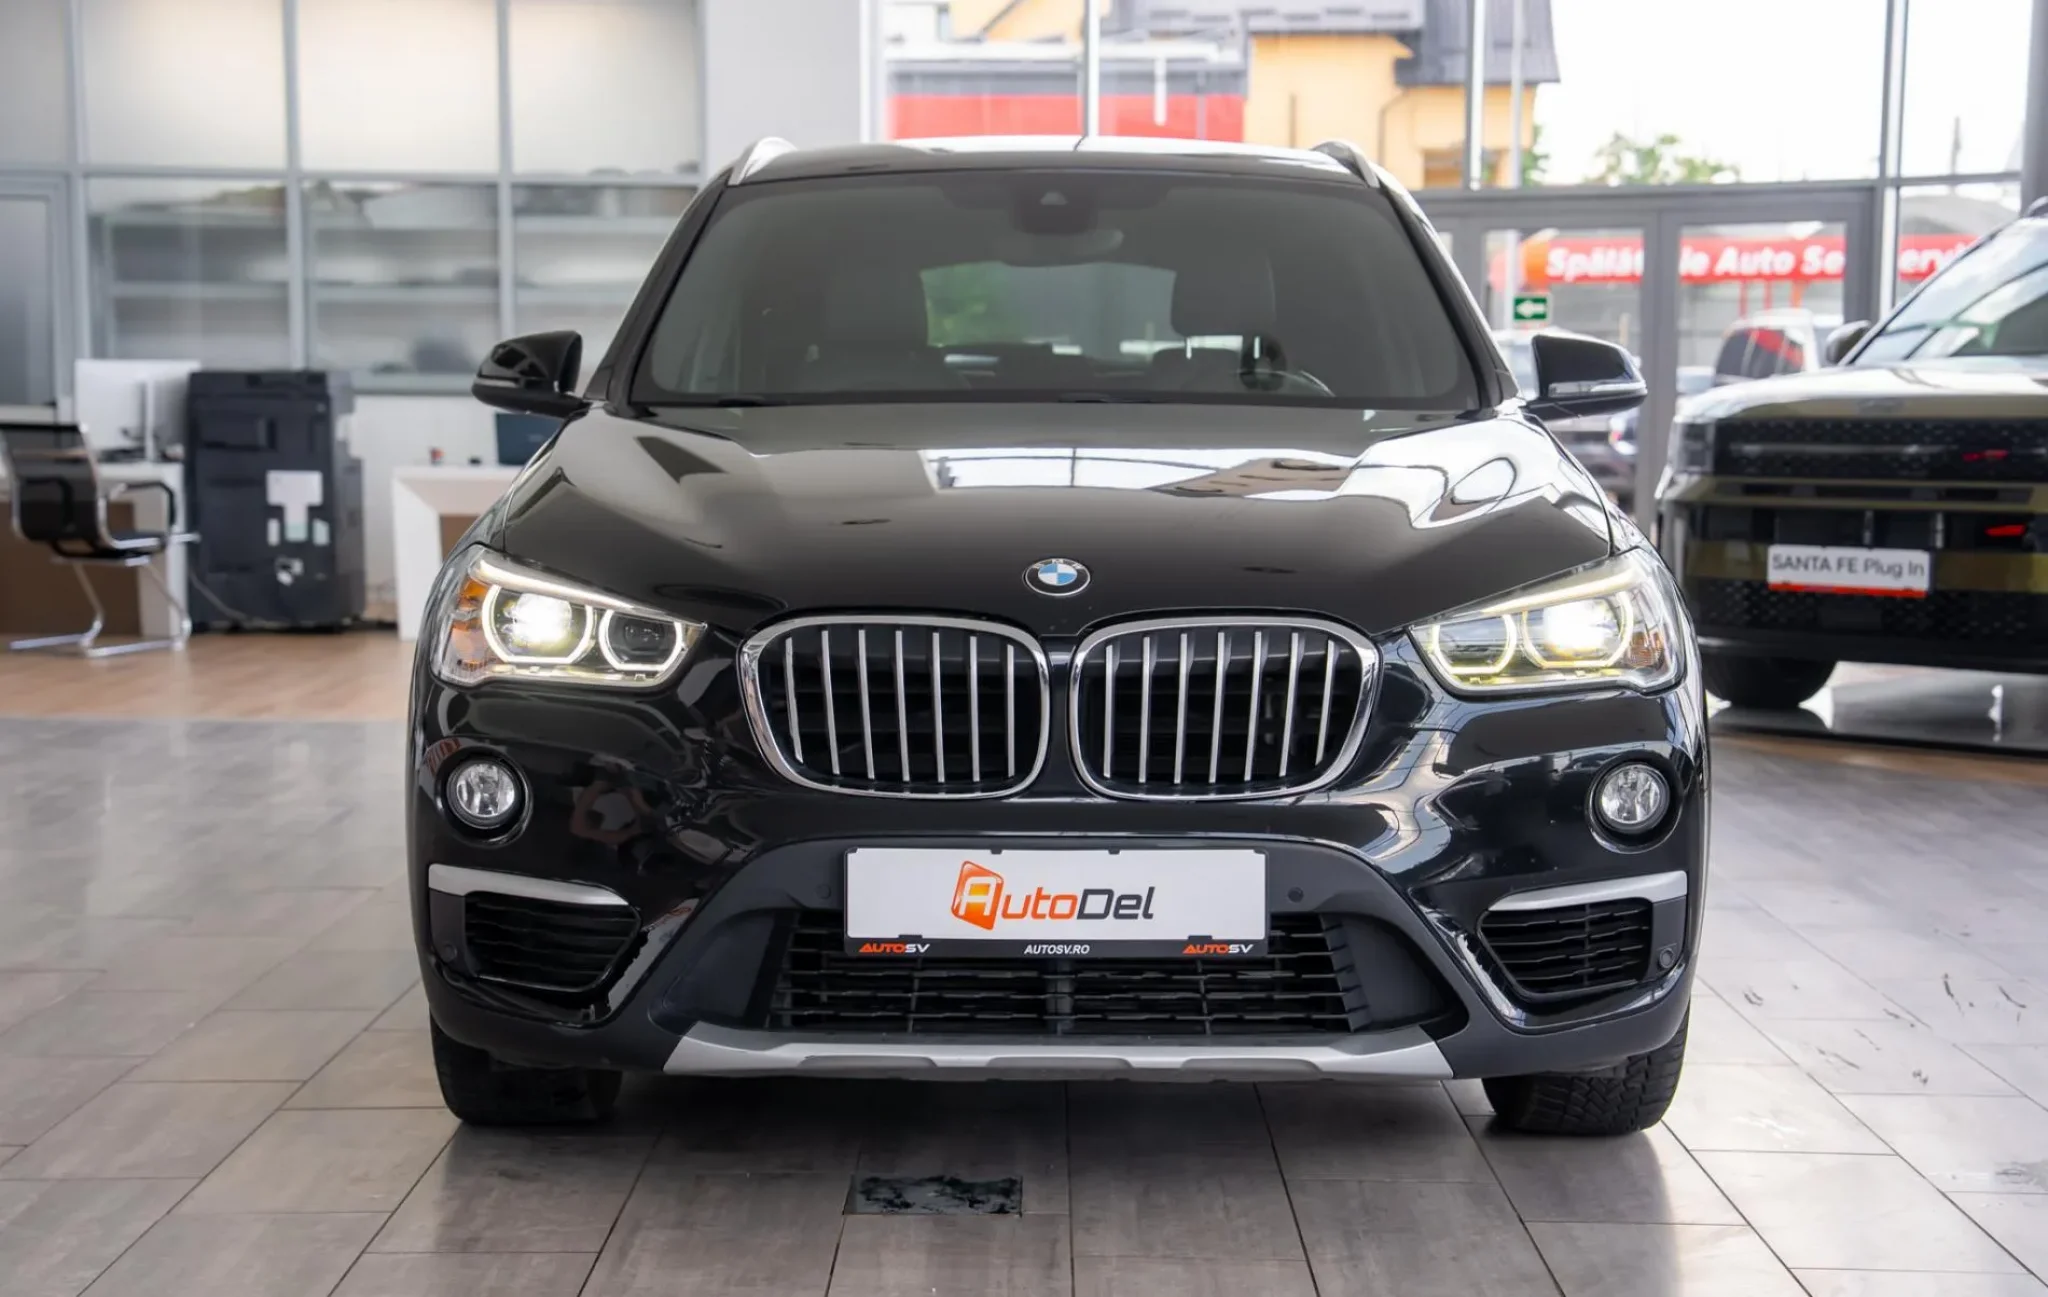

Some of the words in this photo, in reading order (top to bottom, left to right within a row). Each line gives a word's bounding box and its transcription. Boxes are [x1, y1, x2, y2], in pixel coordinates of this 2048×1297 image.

[1715, 246, 1796, 275] Auto
[1772, 553, 1832, 572] SANTA
[1836, 556, 1859, 574] FE
[1863, 557, 1904, 579] Plug
[1908, 559, 1925, 577] In
[859, 943, 930, 953] AUTOSV
[1023, 944, 1091, 955] AUTOSV.RO
[1182, 943, 1254, 954] AUTOSV
